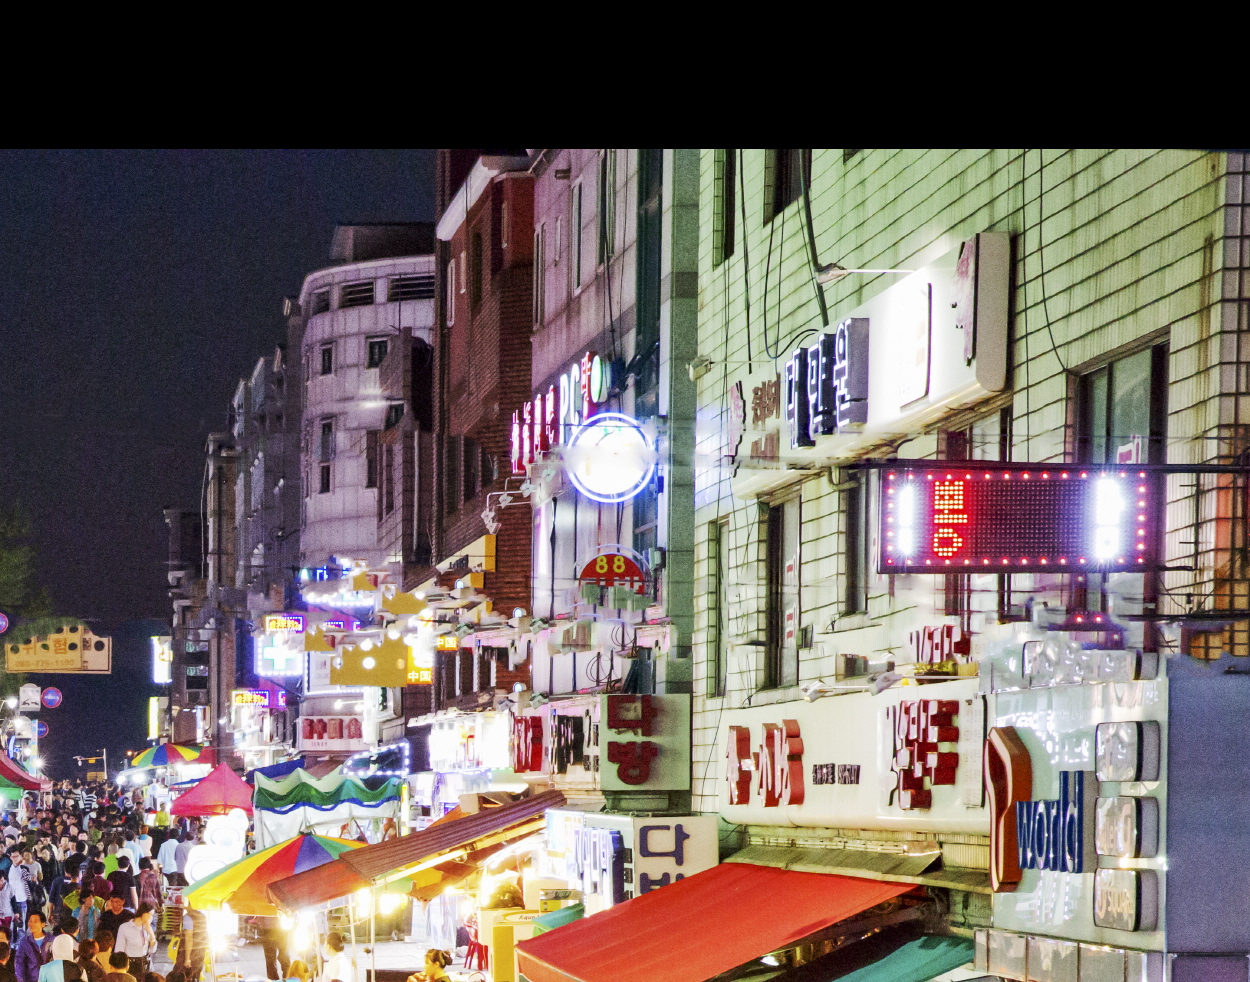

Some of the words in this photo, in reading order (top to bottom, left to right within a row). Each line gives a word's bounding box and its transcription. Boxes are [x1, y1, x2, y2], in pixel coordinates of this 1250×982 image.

[595, 556, 626, 573] 88
[407, 670, 432, 682] 中国
[1015, 770, 1083, 874] world
